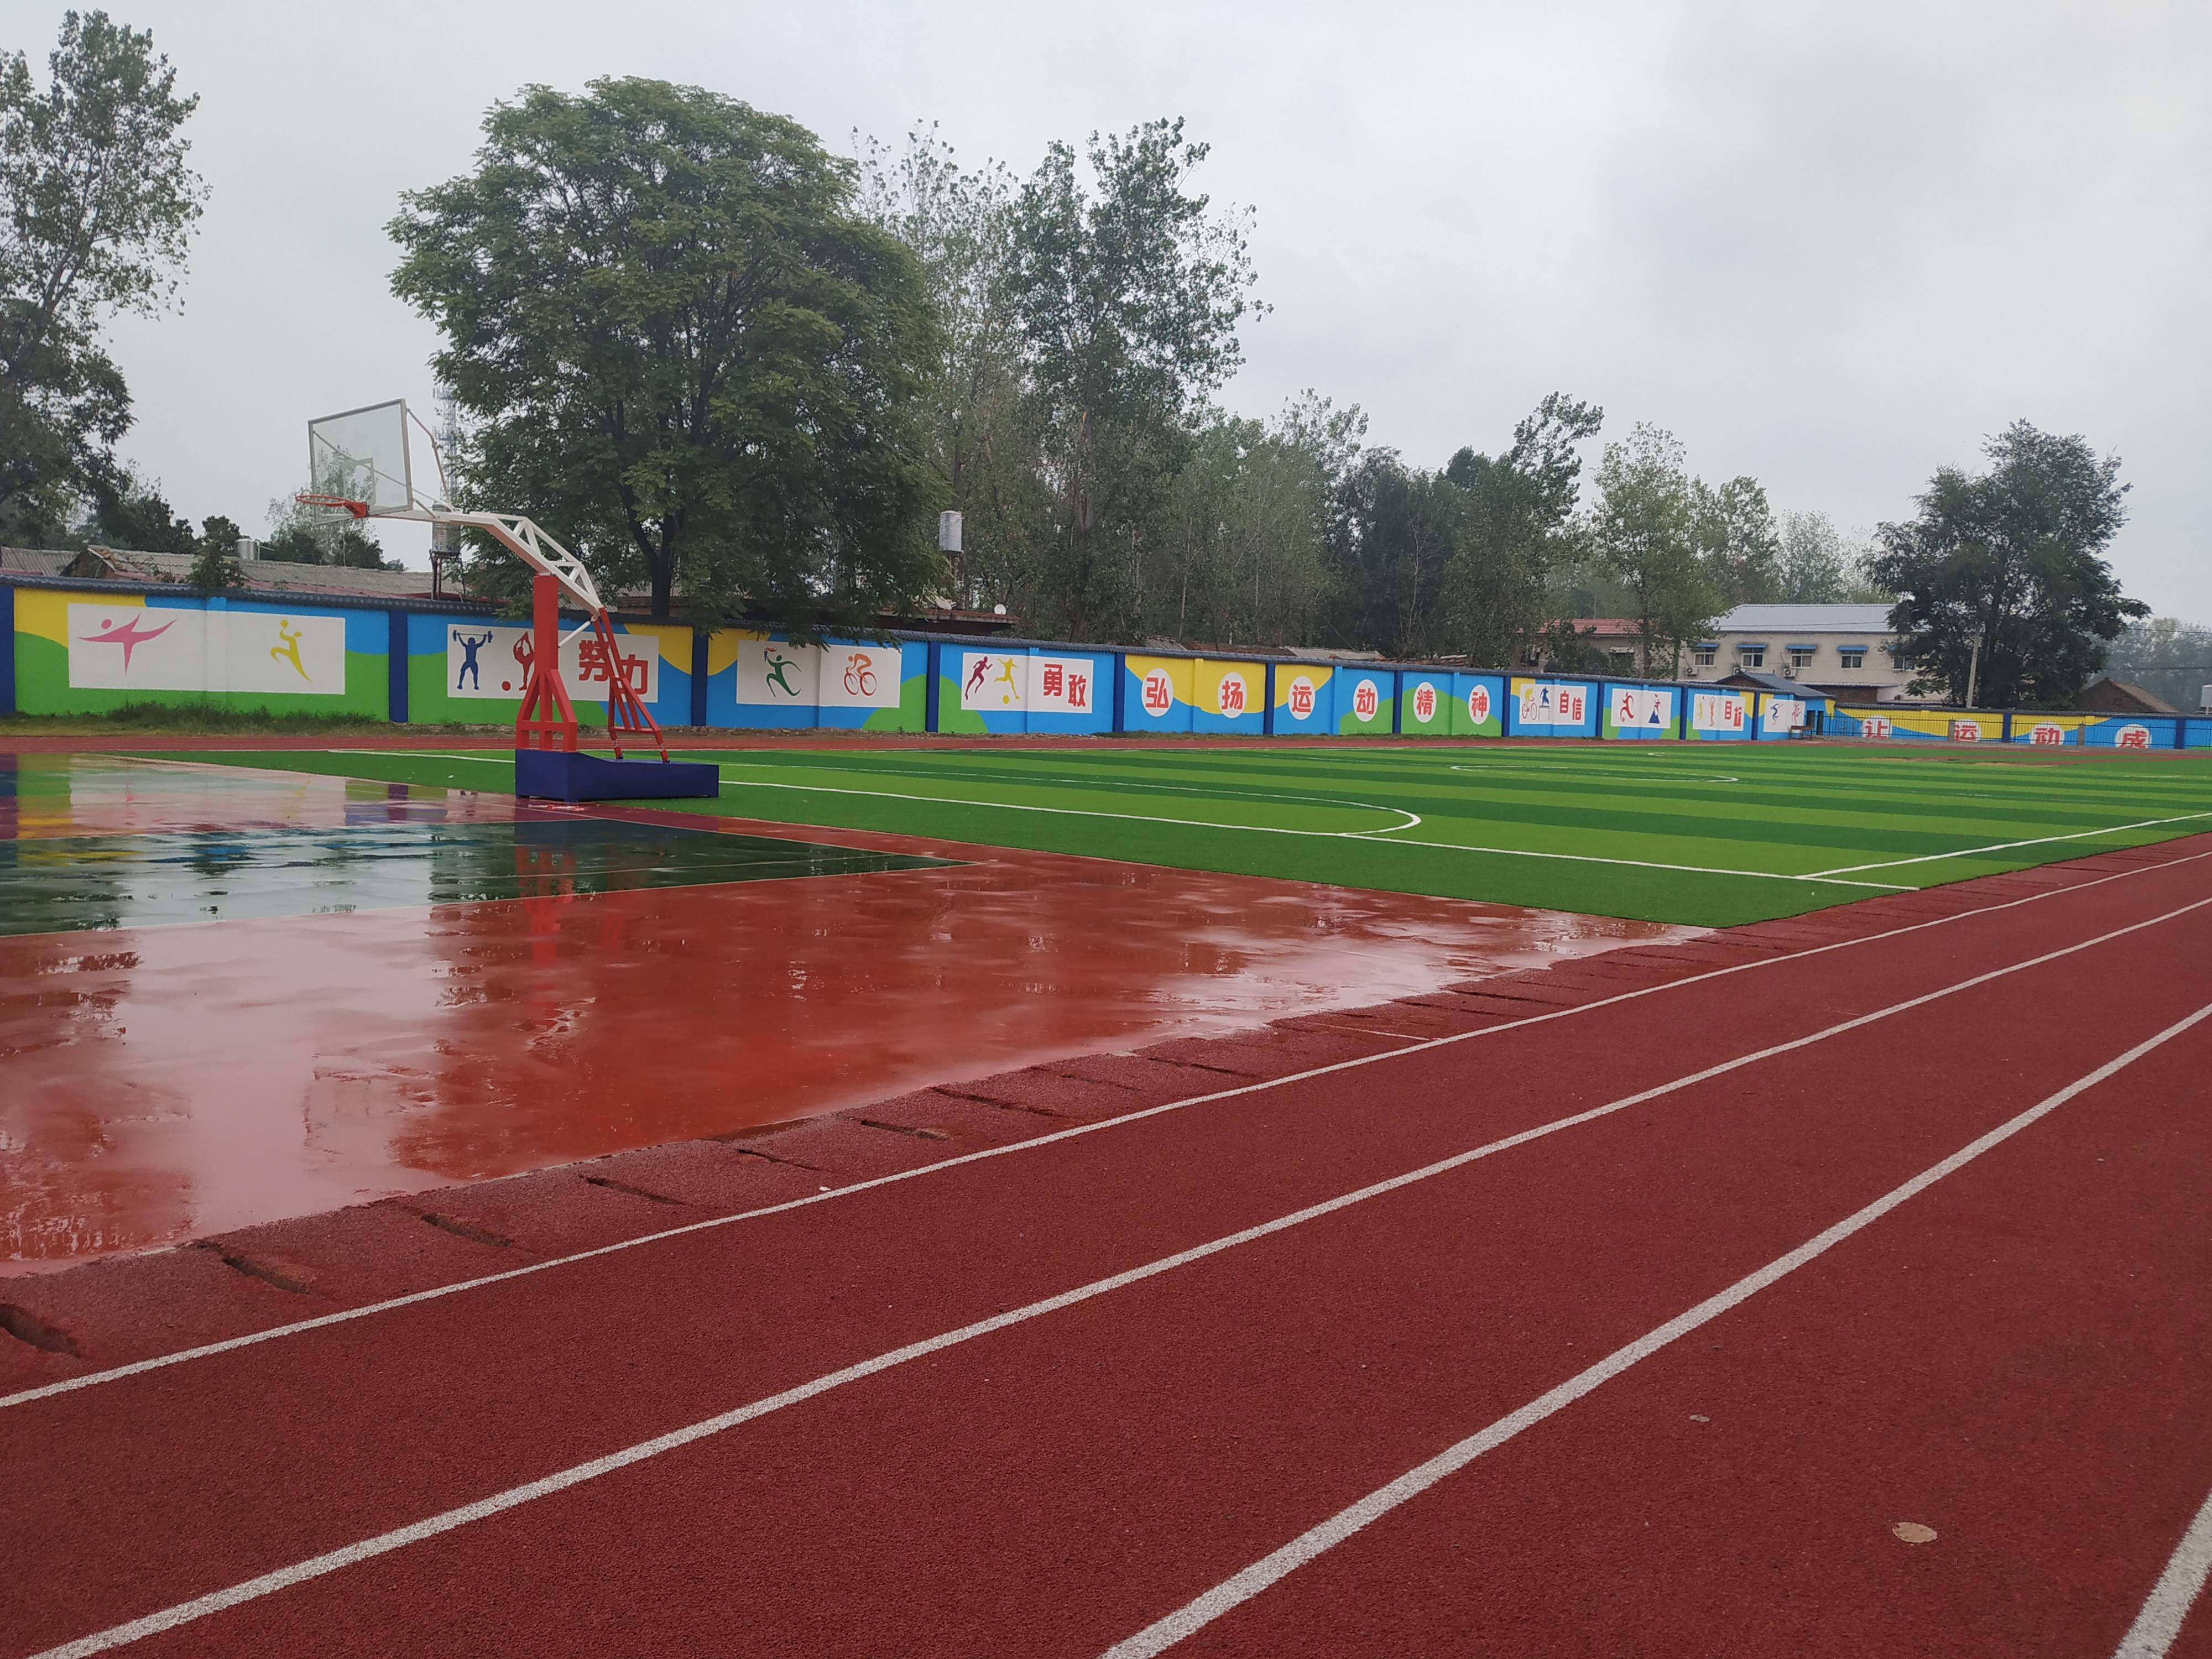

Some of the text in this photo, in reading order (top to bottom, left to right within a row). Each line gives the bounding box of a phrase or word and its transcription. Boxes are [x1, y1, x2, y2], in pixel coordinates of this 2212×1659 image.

[579, 640, 648, 695] 努力
[1043, 663, 1087, 707] 勇敢
[1559, 690, 1582, 721] 自信
